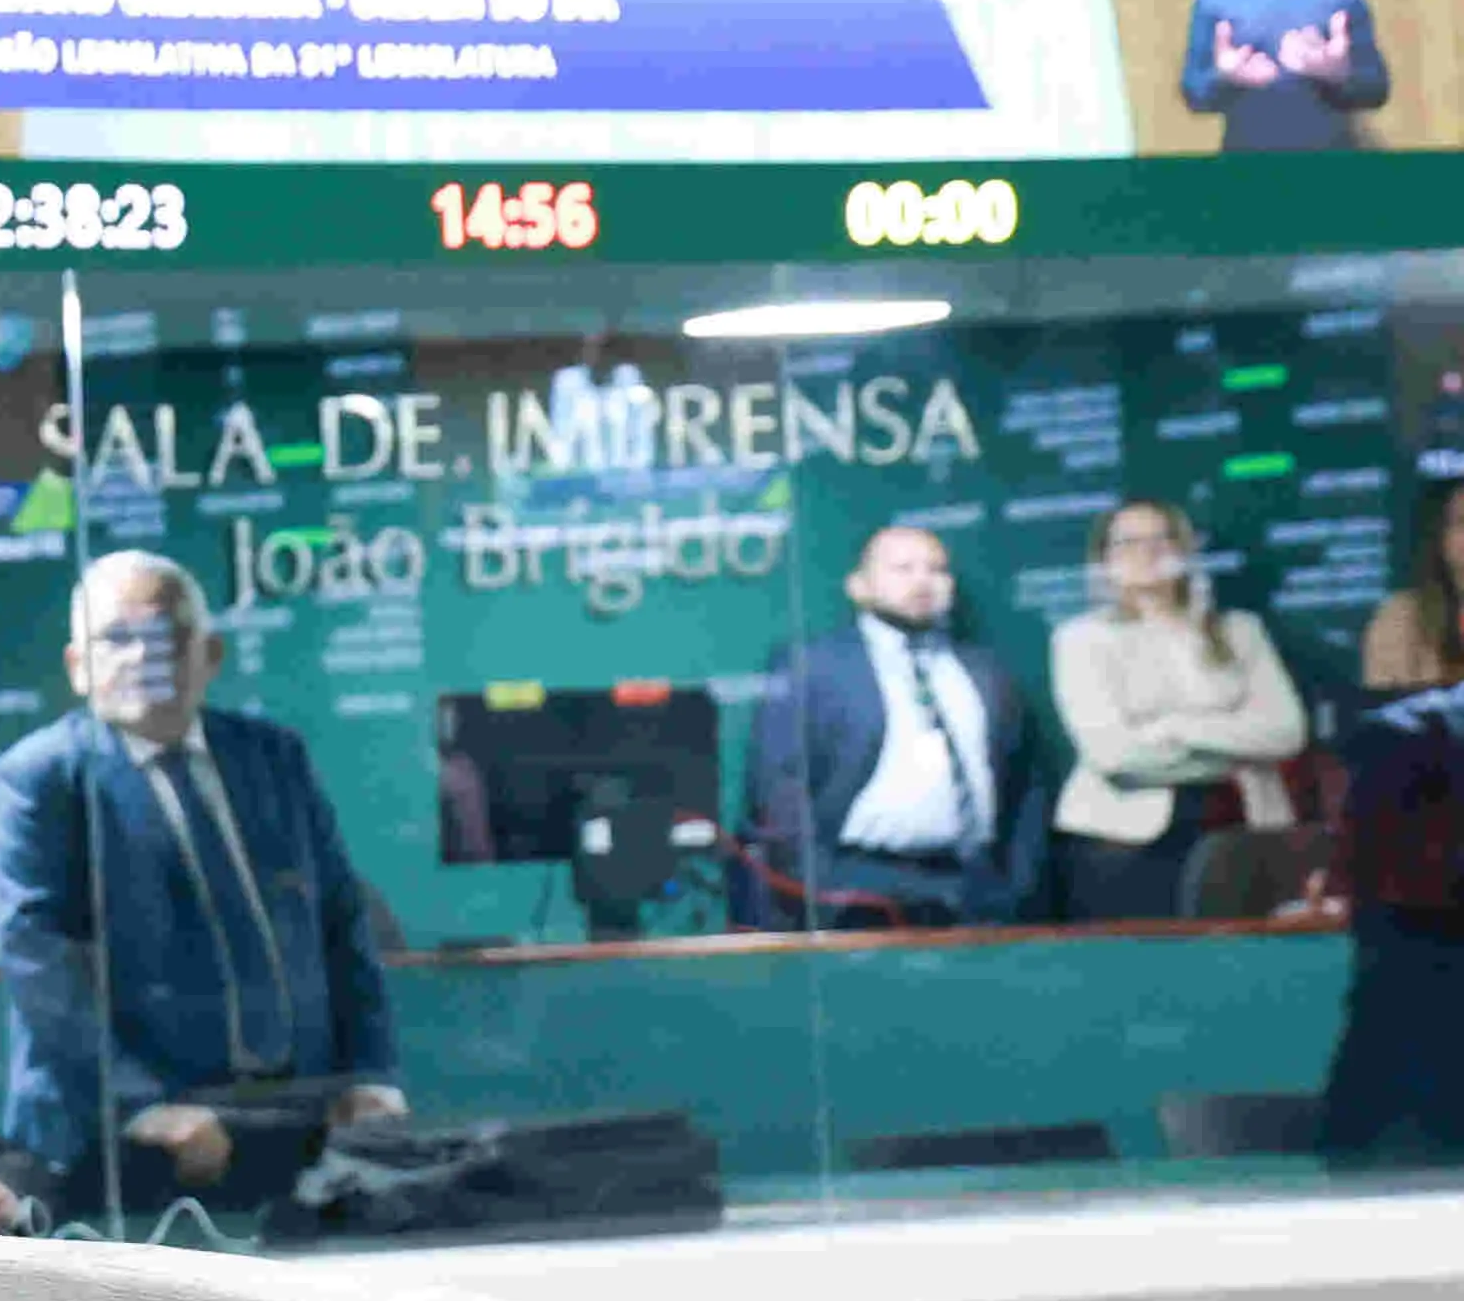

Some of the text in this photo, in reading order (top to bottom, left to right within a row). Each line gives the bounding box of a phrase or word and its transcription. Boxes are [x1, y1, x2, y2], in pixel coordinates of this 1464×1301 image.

[431, 182, 599, 249] 14:56
[845, 179, 1019, 246] 00:00
[38, 401, 278, 489] SALA
[485, 376, 981, 476] IMPRENSA
[232, 511, 427, 611] João
